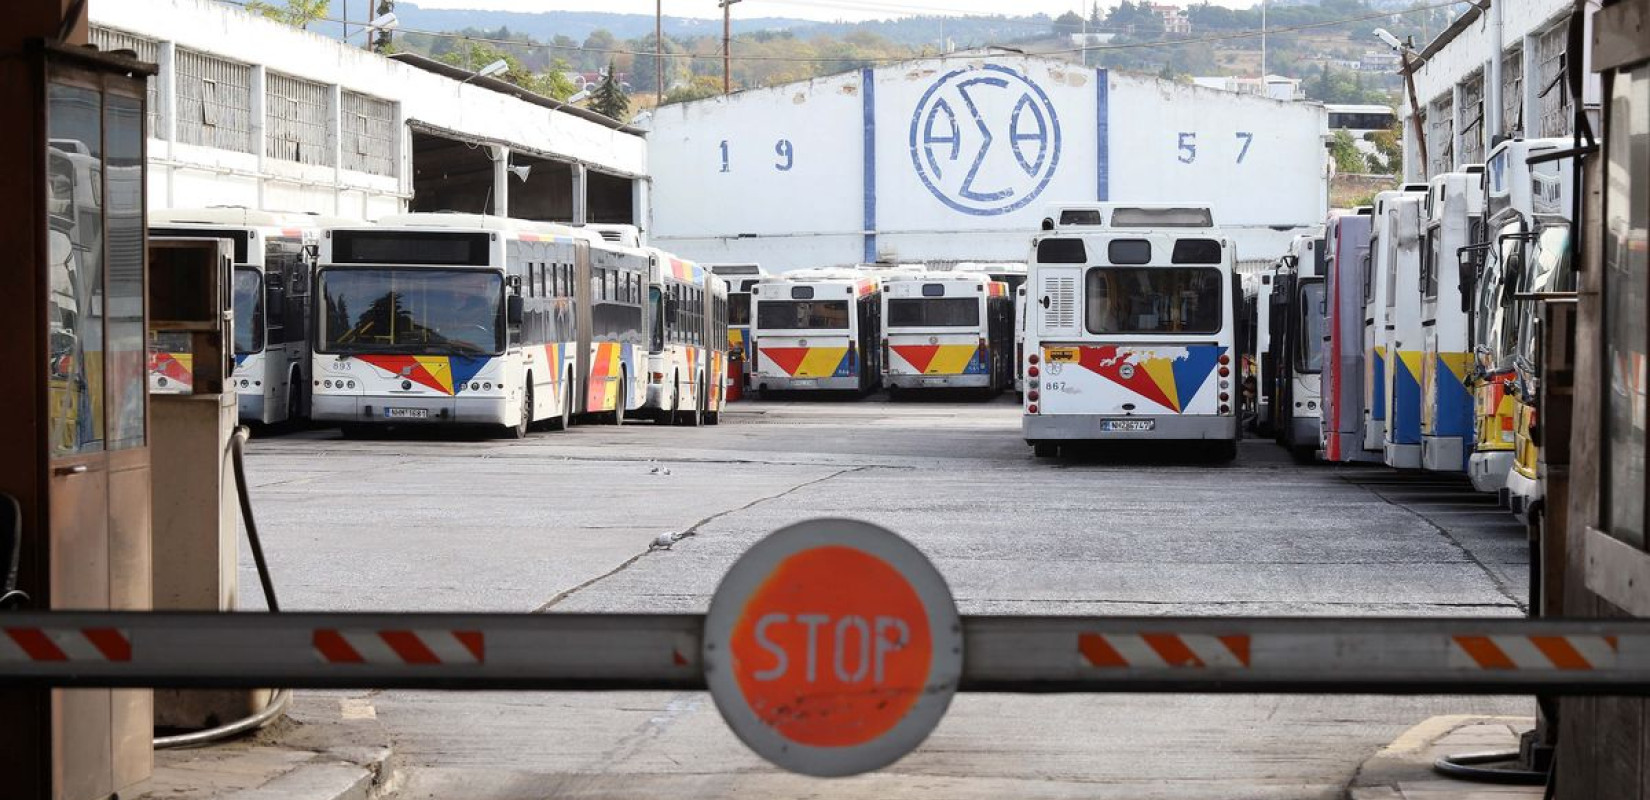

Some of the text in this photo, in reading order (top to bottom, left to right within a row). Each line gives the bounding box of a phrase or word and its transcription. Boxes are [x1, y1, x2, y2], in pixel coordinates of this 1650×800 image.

[719, 139, 793, 173] 1 9
[1178, 131, 1253, 165] 5 7
[332, 361, 352, 371] 893
[1045, 381, 1066, 393] 867
[752, 612, 911, 684] STOP
